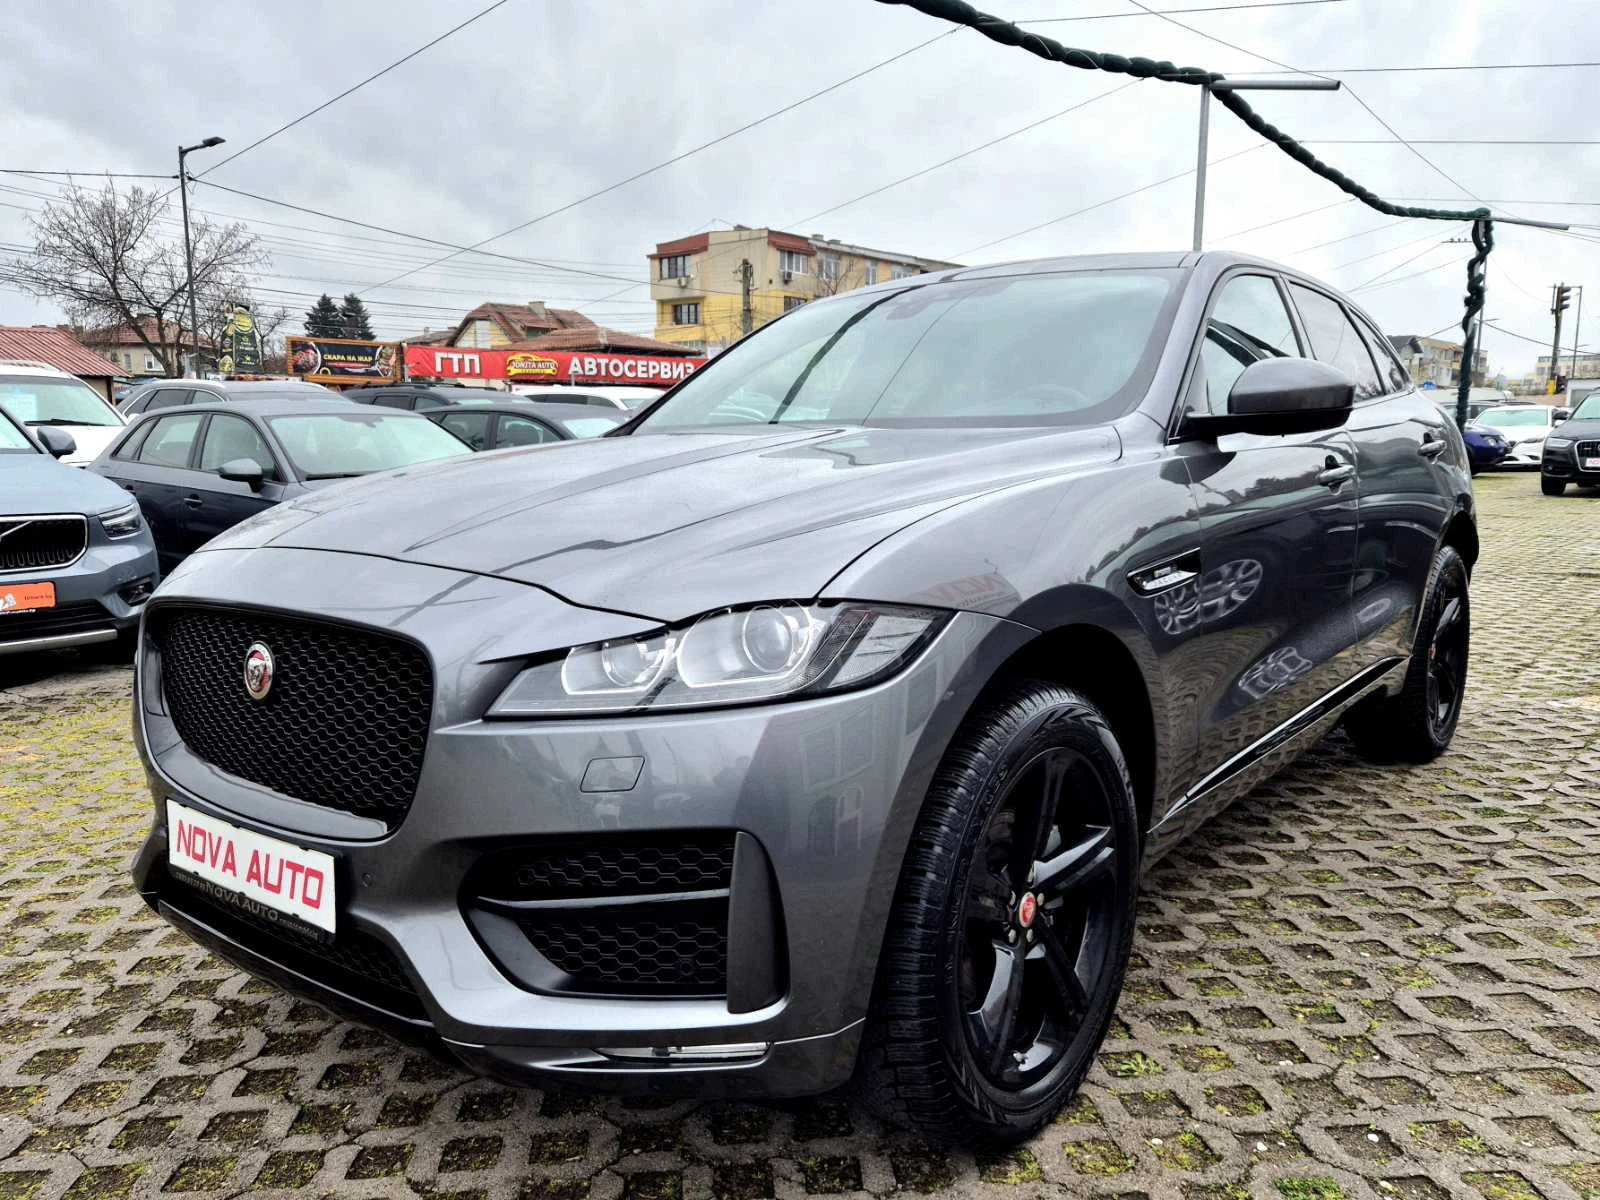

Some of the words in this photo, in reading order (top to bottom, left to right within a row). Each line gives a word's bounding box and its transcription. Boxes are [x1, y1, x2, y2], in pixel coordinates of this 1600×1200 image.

[435, 352, 480, 374] ГТП
[537, 361, 556, 369] AUTO
[568, 355, 696, 380] АВТОСЕРВИЗ
[176, 819, 237, 877] NOVA
[246, 849, 324, 910] AUTO
[205, 881, 241, 906] NOVA
[242, 900, 279, 921] AUTO
